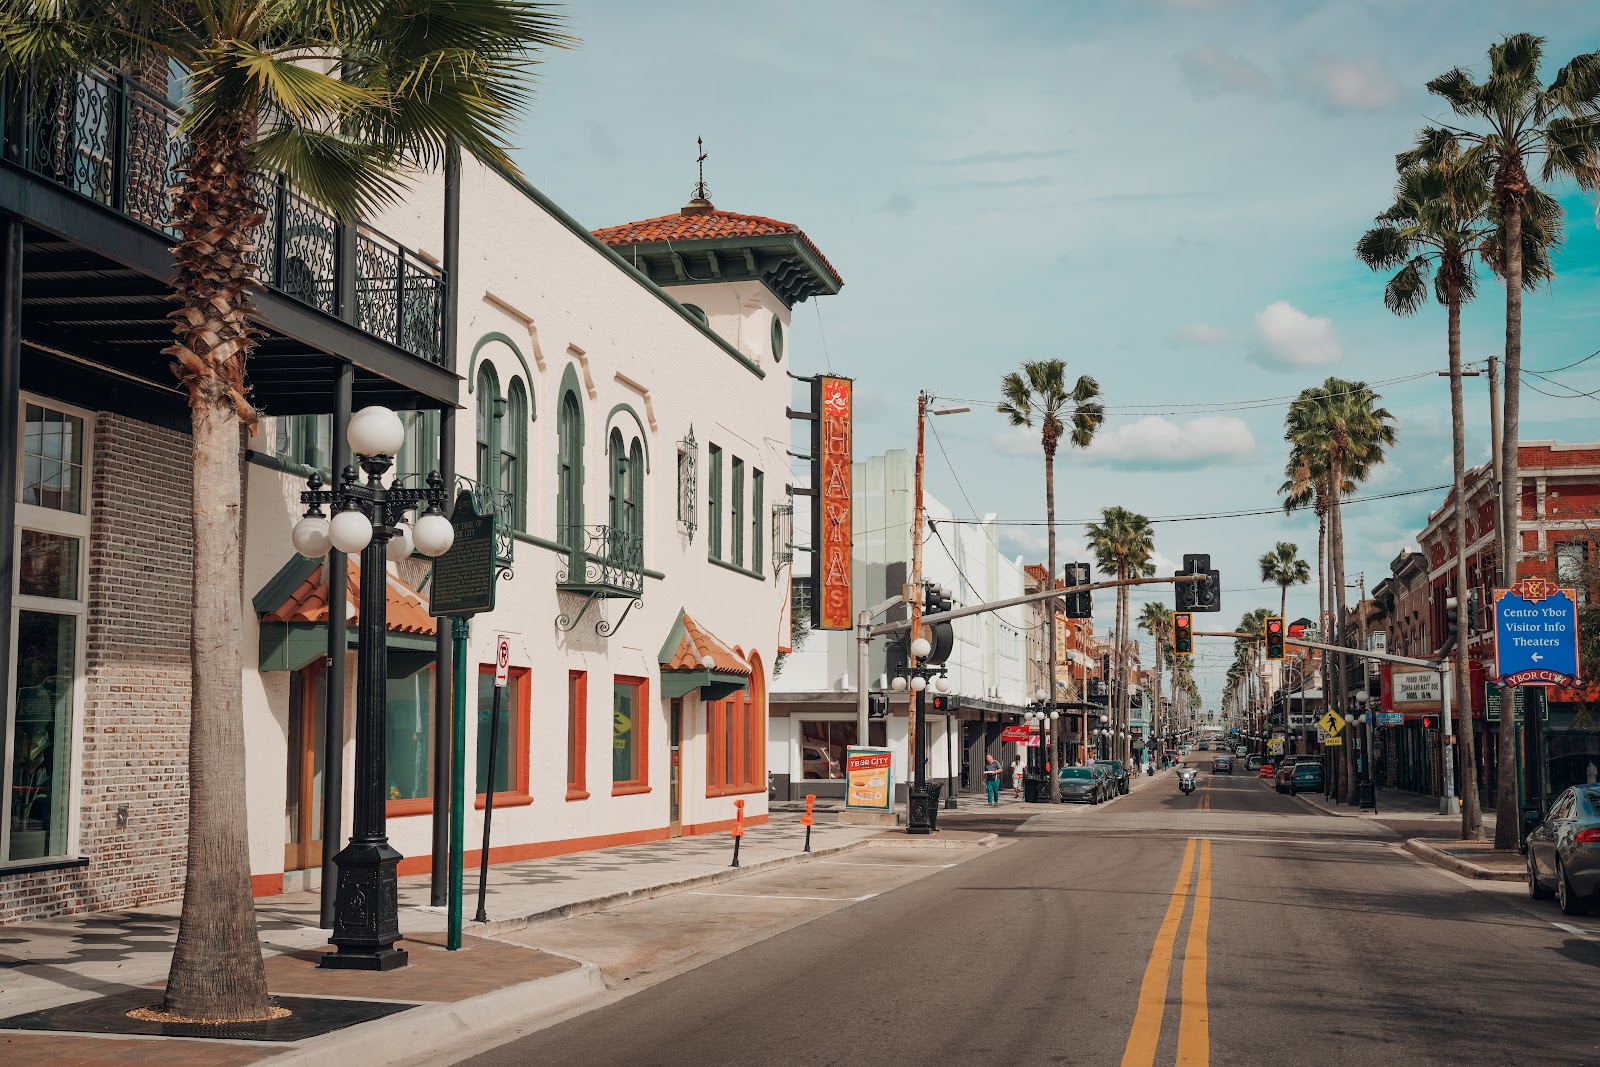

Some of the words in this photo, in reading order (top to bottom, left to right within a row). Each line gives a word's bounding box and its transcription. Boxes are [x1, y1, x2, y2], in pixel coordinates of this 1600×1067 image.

[825, 392, 848, 411] Las
[1503, 608, 1539, 618] Centro
[1541, 608, 1567, 617] Ybor
[1505, 622, 1541, 632] Visitor
[1544, 622, 1566, 631] Info
[1512, 637, 1560, 647] Theaters
[1508, 672, 1537, 684] YBOR
[871, 757, 888, 765] CITY
